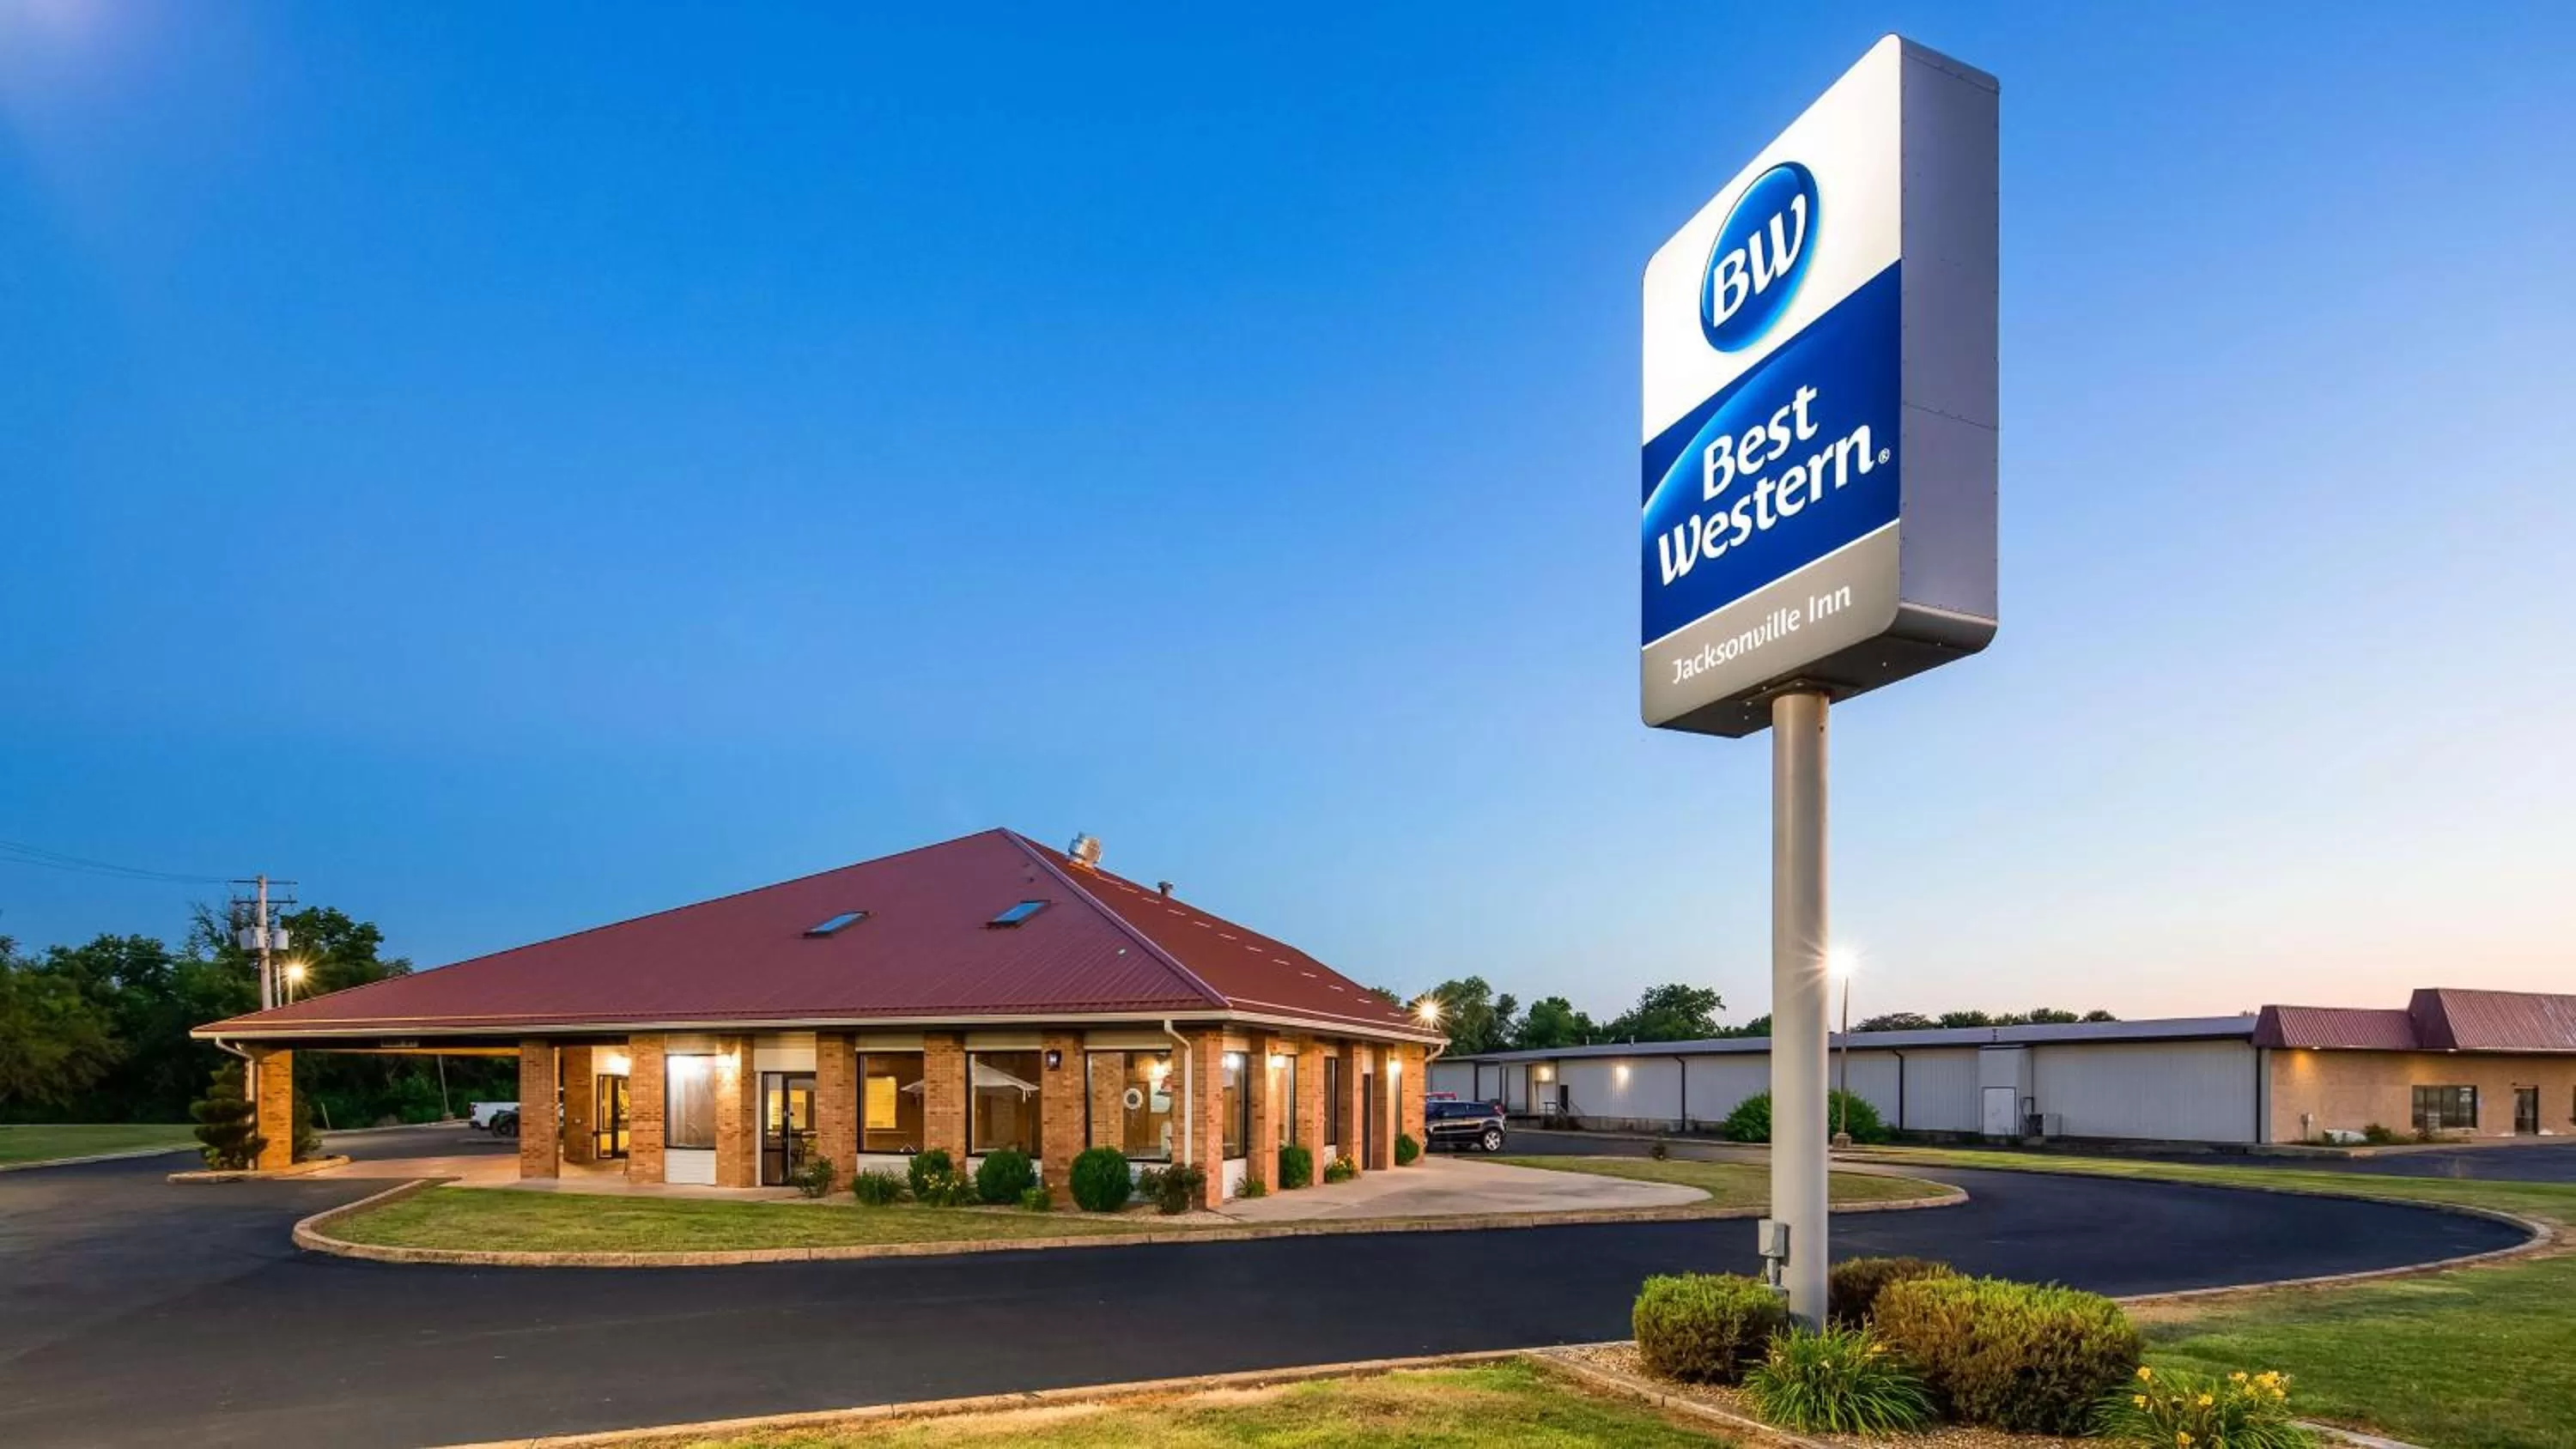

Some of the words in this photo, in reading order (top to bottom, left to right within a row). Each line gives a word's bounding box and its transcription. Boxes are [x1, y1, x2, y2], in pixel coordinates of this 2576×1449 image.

[1713, 194, 1806, 328] BW
[1703, 385, 1819, 501] Best
[1673, 608, 1801, 684] Jacksonville
[1808, 585, 1851, 622] Inn
